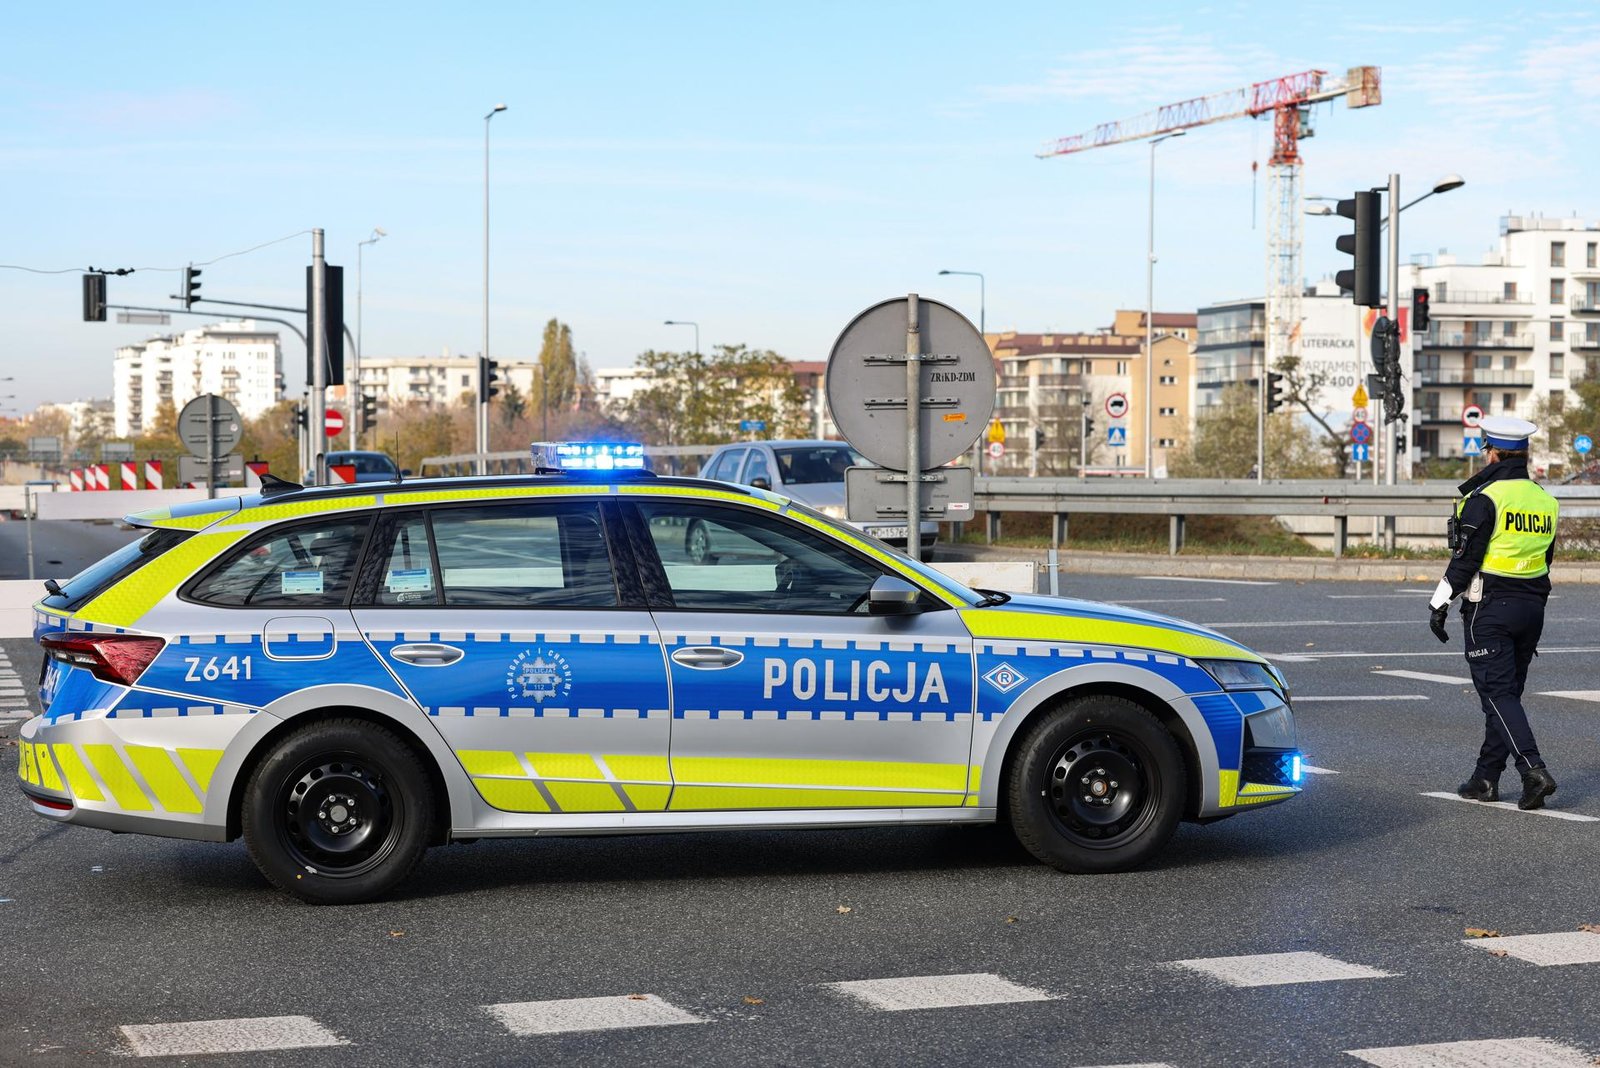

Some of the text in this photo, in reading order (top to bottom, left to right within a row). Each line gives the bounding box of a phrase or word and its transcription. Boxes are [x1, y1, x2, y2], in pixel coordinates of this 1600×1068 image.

[1302, 339, 1355, 348] LITERACKA
[931, 372, 976, 382] ZRiKD-ZDM
[1330, 376, 1354, 387] 400
[1505, 512, 1552, 534] POLICJA
[184, 656, 251, 682] Z641
[506, 649, 530, 699] POMAGAMY
[547, 650, 572, 697] CHRONIMY
[763, 658, 949, 703] POLICJA
